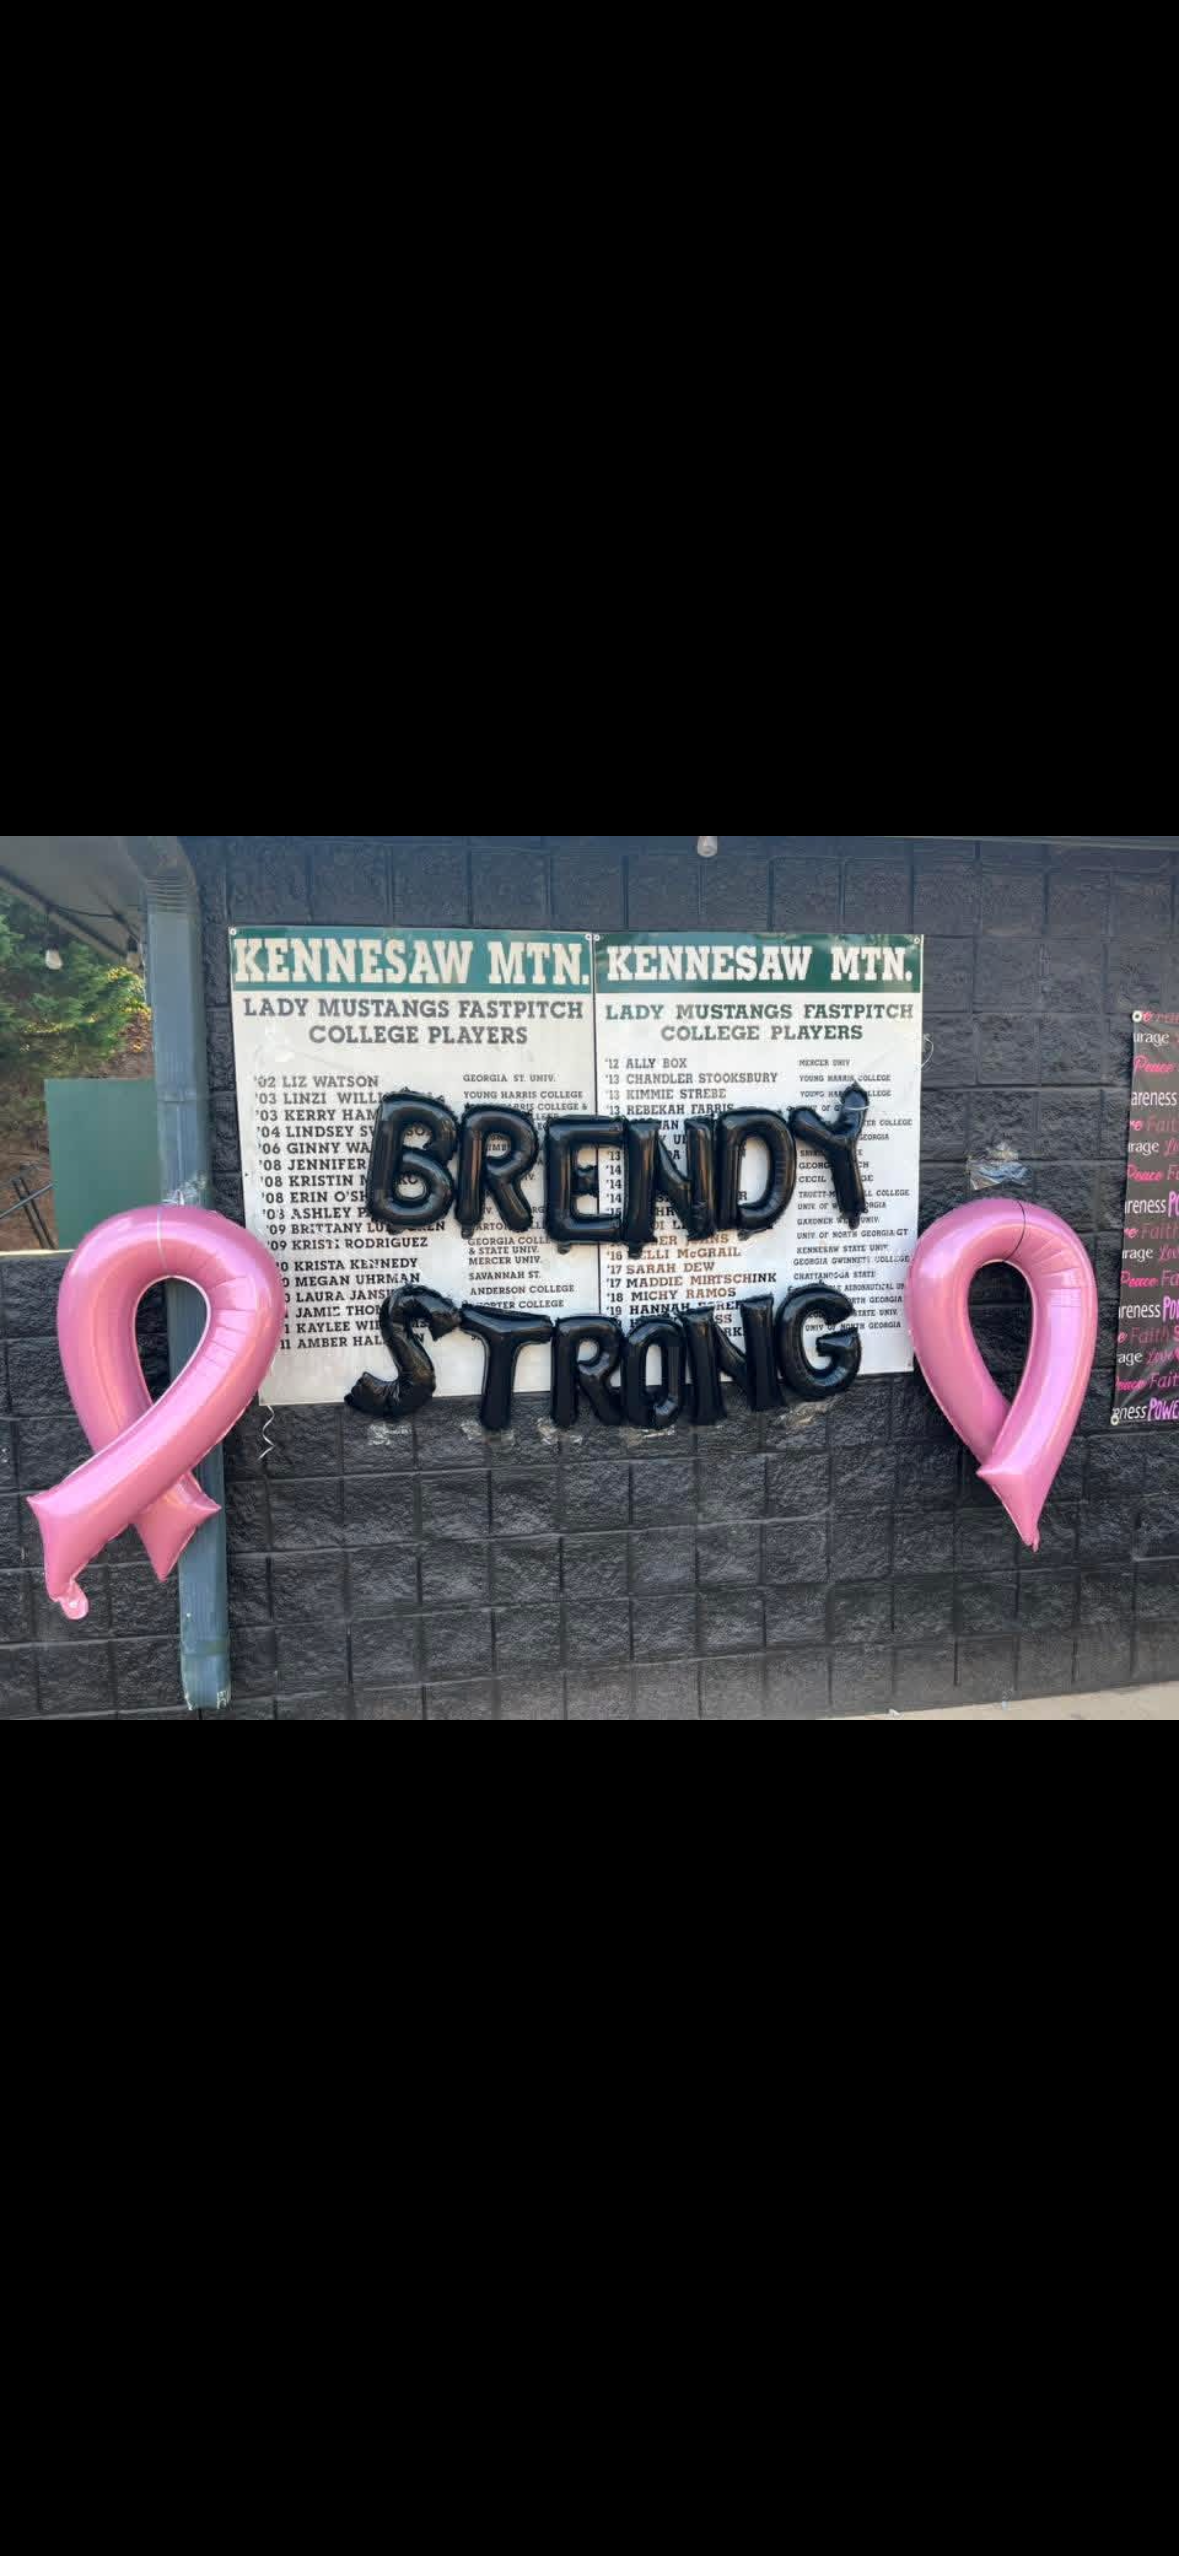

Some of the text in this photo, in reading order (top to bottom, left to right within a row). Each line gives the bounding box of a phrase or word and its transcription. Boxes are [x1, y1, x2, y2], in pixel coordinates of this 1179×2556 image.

[233, 938, 590, 986] KENNESAW MTN.
[606, 945, 913, 981] KENNESAW MTN.
[243, 998, 584, 1020] LADY MUSTANGS FASTPITCH
[606, 1003, 914, 1021] LADY MUSTANGS FASTPITCH
[309, 1025, 528, 1044] COLLEGE PLAYERS
[660, 1025, 863, 1042] COLLEGE PLAYERS
[626, 1058, 656, 1069] ALLY
[663, 1058, 687, 1068] BOX
[282, 1075, 307, 1088] LIZ
[312, 1075, 379, 1087] WATSON
[463, 1073, 508, 1082] GEORGIA
[626, 1073, 693, 1084] CHANDLER
[698, 1072, 778, 1084] STOOKSBURY
[858, 1074, 891, 1082] COLLEGE
[283, 1092, 326, 1104] LINZI
[463, 1091, 583, 1099] YOUNG HARRIS COLLEGE
[626, 1089, 674, 1100] KIMMIE
[680, 1088, 727, 1099] STREBE
[538, 1103, 580, 1111] COLLEGE
[626, 1104, 685, 1115] REBEKAH
[284, 1109, 336, 1121] KERRY
[285, 1126, 354, 1138] LINDSEY
[286, 1142, 340, 1154] GINNY
[287, 1159, 367, 1171] JENNIFER
[367, 1083, 869, 1254] BRENDY
[289, 1175, 353, 1187] KRISTIN
[798, 1175, 827, 1183] CECIL
[290, 1191, 328, 1203] ERIN
[876, 1189, 910, 1197] COLLEGE
[1125, 1199, 1166, 1213] reness
[291, 1207, 351, 1220] ASHLEY
[291, 1223, 362, 1235] BRITTANY
[345, 1237, 428, 1249] RODRIGUEZ
[468, 1237, 515, 1246] GEORGIA
[478, 1246, 509, 1254] STATE
[677, 1247, 741, 1259] McGRAIL
[797, 1245, 839, 1254] KENNESAW
[843, 1244, 866, 1252] STATE
[294, 1258, 418, 1272] KRISTA KENNEDY
[469, 1256, 512, 1266] MERCER
[793, 1257, 828, 1266] GEORGIA
[626, 1262, 676, 1274] SARAH
[683, 1262, 715, 1273] DEW
[296, 1273, 420, 1287] MEGAN UHRMAN
[468, 1271, 525, 1280] SAVANNAH
[626, 1276, 683, 1288] MADDIE
[690, 1273, 777, 1285] MIRTSCHINK
[470, 1284, 574, 1295] ANDERSON COLLEGE
[631, 1290, 678, 1301] MICHY
[685, 1287, 737, 1299] RAMOS
[296, 1290, 347, 1303] LAURA
[518, 1300, 564, 1308] COLLEGE
[629, 1303, 690, 1315] HANNAH
[296, 1306, 340, 1318] JAMIE
[1119, 1304, 1161, 1319] reness
[296, 1321, 350, 1333] KAYLEE
[297, 1337, 347, 1349] AMBER
[344, 1284, 862, 1430] STRONG
